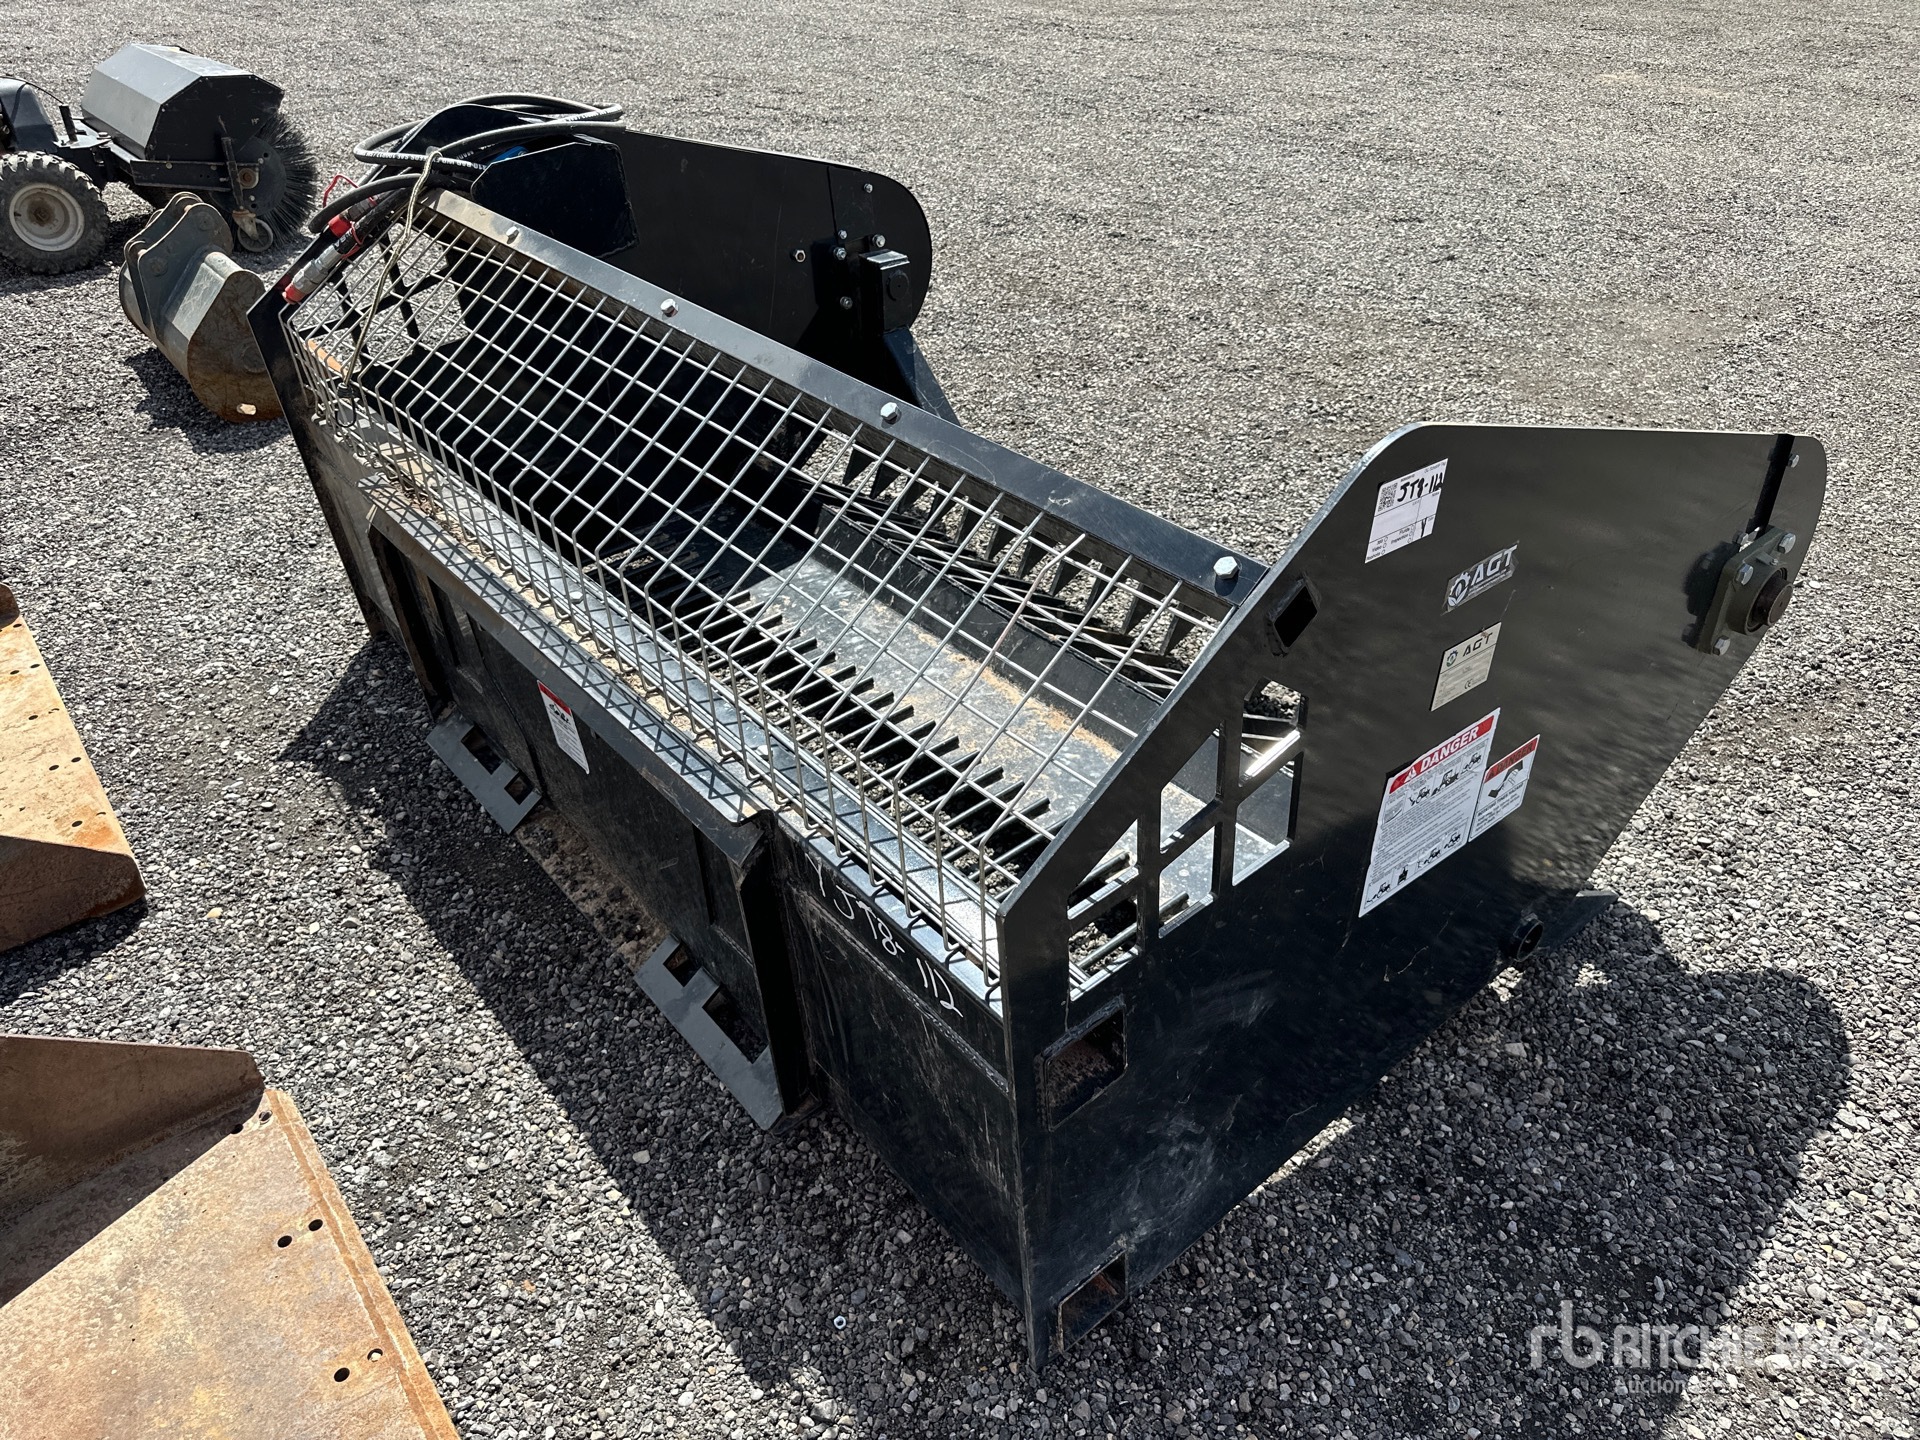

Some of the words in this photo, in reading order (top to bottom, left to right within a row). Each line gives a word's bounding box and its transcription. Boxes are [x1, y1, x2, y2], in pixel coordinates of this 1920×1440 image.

[1471, 544, 1517, 586] AGT
[1463, 632, 1493, 657] AGT
[1420, 726, 1480, 772] DANGER
